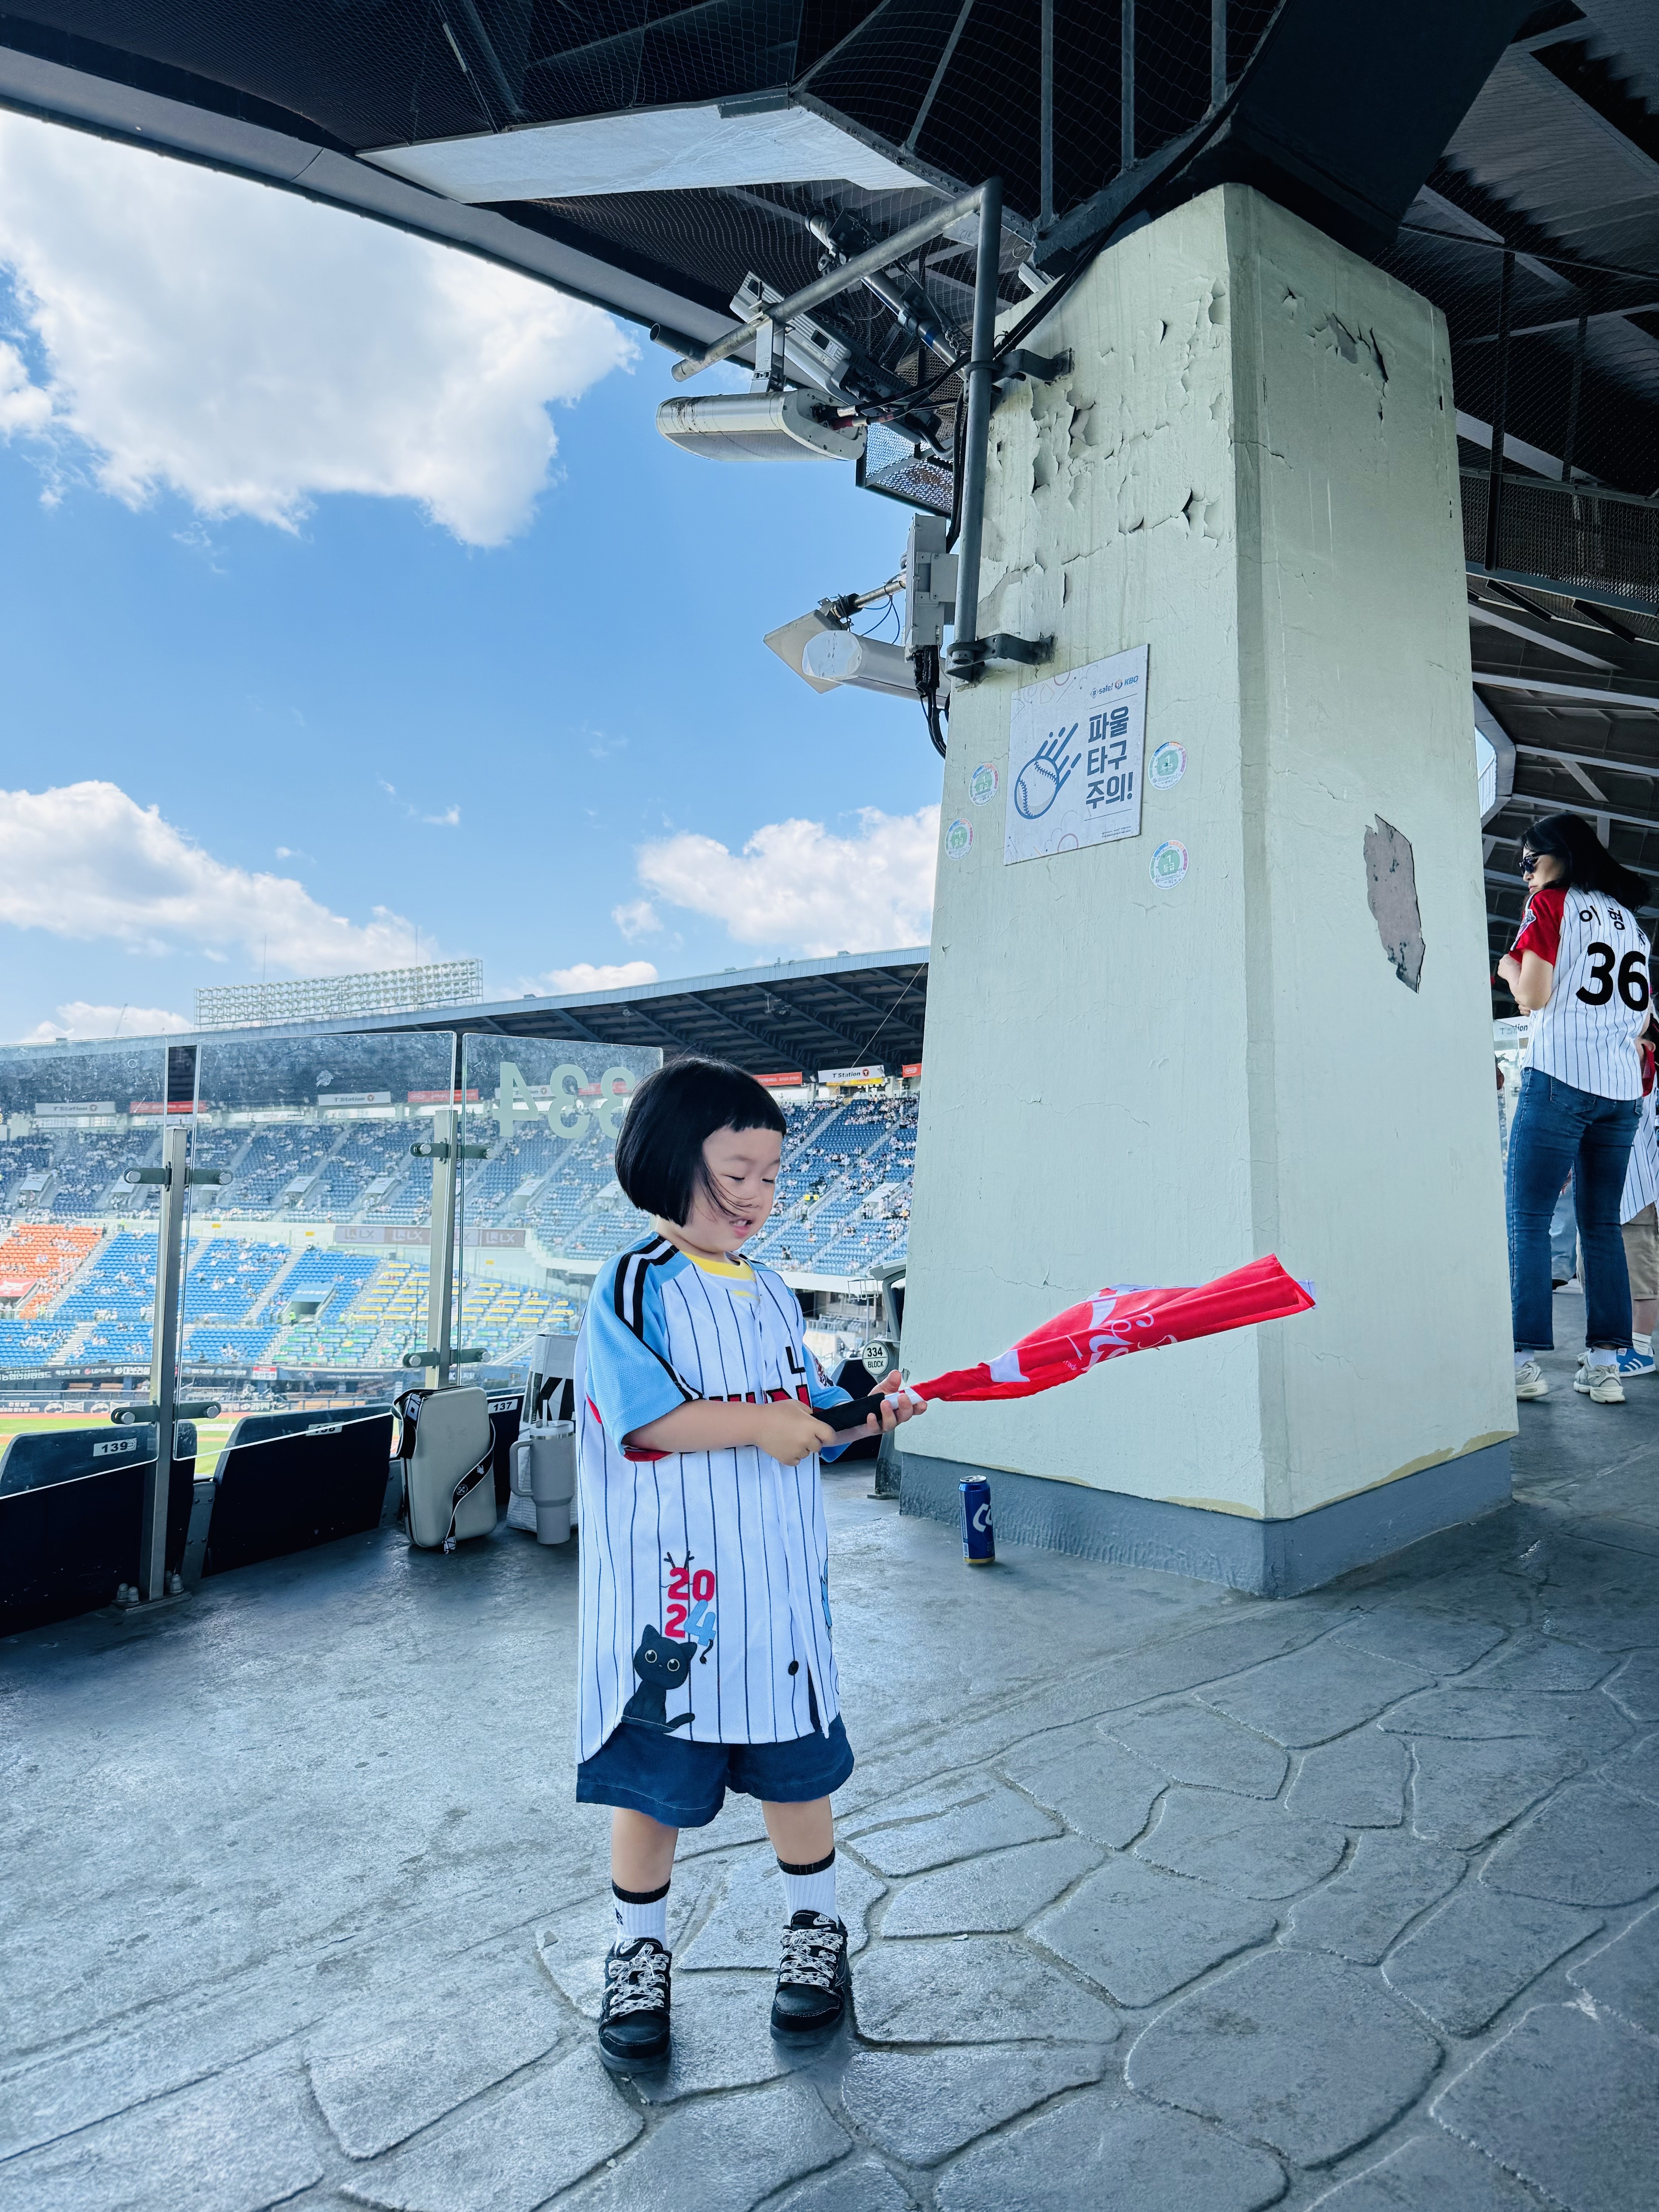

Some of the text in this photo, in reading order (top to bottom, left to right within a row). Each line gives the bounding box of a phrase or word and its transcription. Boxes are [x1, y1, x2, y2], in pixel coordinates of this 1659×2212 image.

[1099, 683, 1113, 694] safe!
[1124, 675, 1138, 686] KBO
[1087, 706, 1130, 743] 파울
[1086, 740, 1127, 776] 타구
[1165, 755, 1170, 763] 1
[1085, 771, 1133, 810] 주의!
[955, 838, 963, 846] 등급
[1166, 855, 1171, 863] 1
[1163, 862, 1175, 872] 등급
[1575, 942, 1649, 1012] 36
[359, 1229, 374, 1239] LX
[407, 1230, 422, 1240] LX
[500, 1233, 515, 1242] LX
[867, 1347, 883, 1357] 334
[493, 1401, 512, 1411] 137
[102, 1441, 128, 1453] 139
[668, 1567, 715, 1602] 20
[665, 1599, 716, 1646] 24
[817, 1913, 830, 1923] NIKE
[623, 1939, 635, 1949] NIKE
